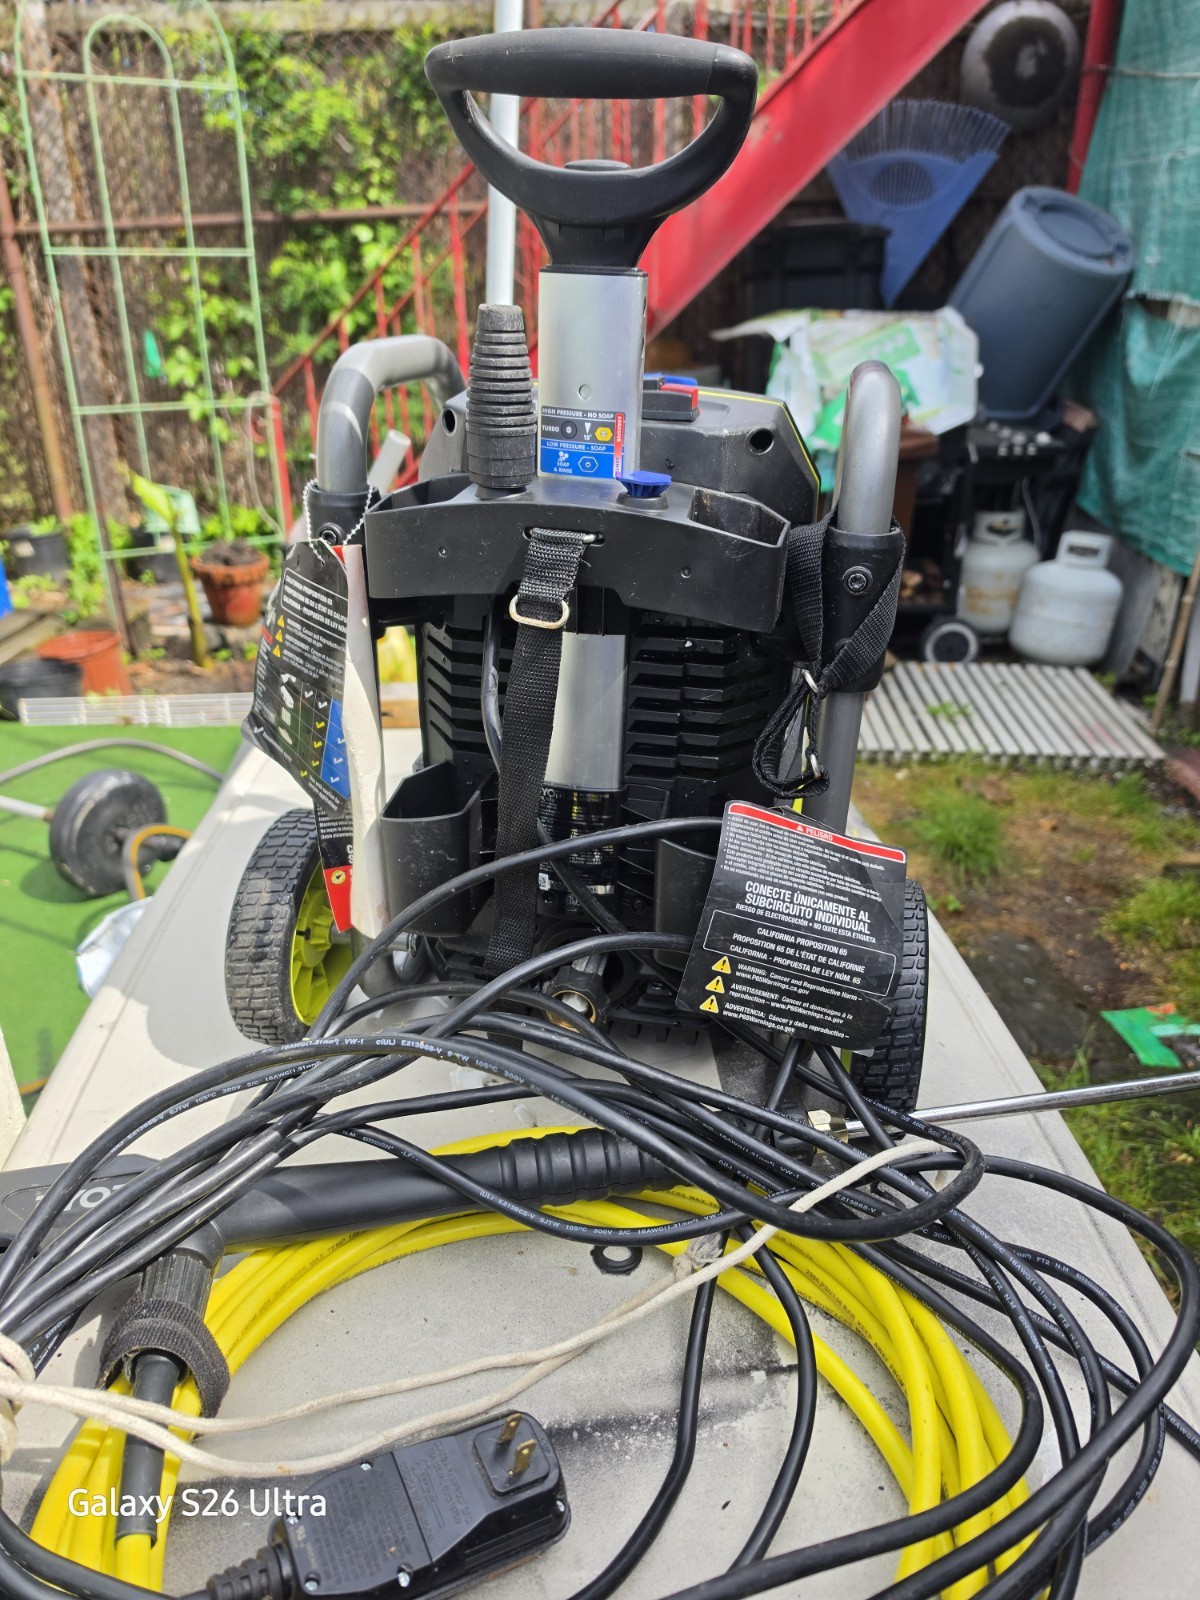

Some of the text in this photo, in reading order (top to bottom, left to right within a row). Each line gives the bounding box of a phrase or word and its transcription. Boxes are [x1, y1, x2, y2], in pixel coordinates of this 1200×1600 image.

[557, 409, 582, 417] PRESSURE
[559, 442, 586, 450] PRESSURE
[805, 827, 834, 842] PELIGRO
[744, 880, 872, 923] CONECTE ÚNICAMENTE AL
[744, 892, 872, 934] SUBCIRCUITO INDIVIDUAL
[735, 902, 756, 913] RIESGO
[756, 907, 764, 915] DE
[764, 909, 808, 926] ELECTROCUCIÓN
[821, 924, 834, 933] QUITE
[837, 928, 852, 937] ESTA
[851, 932, 876, 943] ETIQUETA
[732, 932, 865, 973] PROPOSITION 65 DE L'ÉTAT DE CALIFORNIE
[756, 927, 848, 956] CALIFORNIA PROPOSITION 65
[730, 944, 861, 985] CALIFORNIA PROPUESTA DE LEY NÚM. 65
[736, 963, 767, 976] WARNING:
[768, 972, 790, 983] Cancer
[790, 977, 802, 986] and
[802, 981, 841, 996] Reproductive
[781, 996, 802, 1006] Cancer
[375, 1038, 396, 1046] c(UL)
[504, 1070, 525, 1084] 300V
[970, 1224, 989, 1239] 300V
[991, 1275, 1003, 1290] FT2
